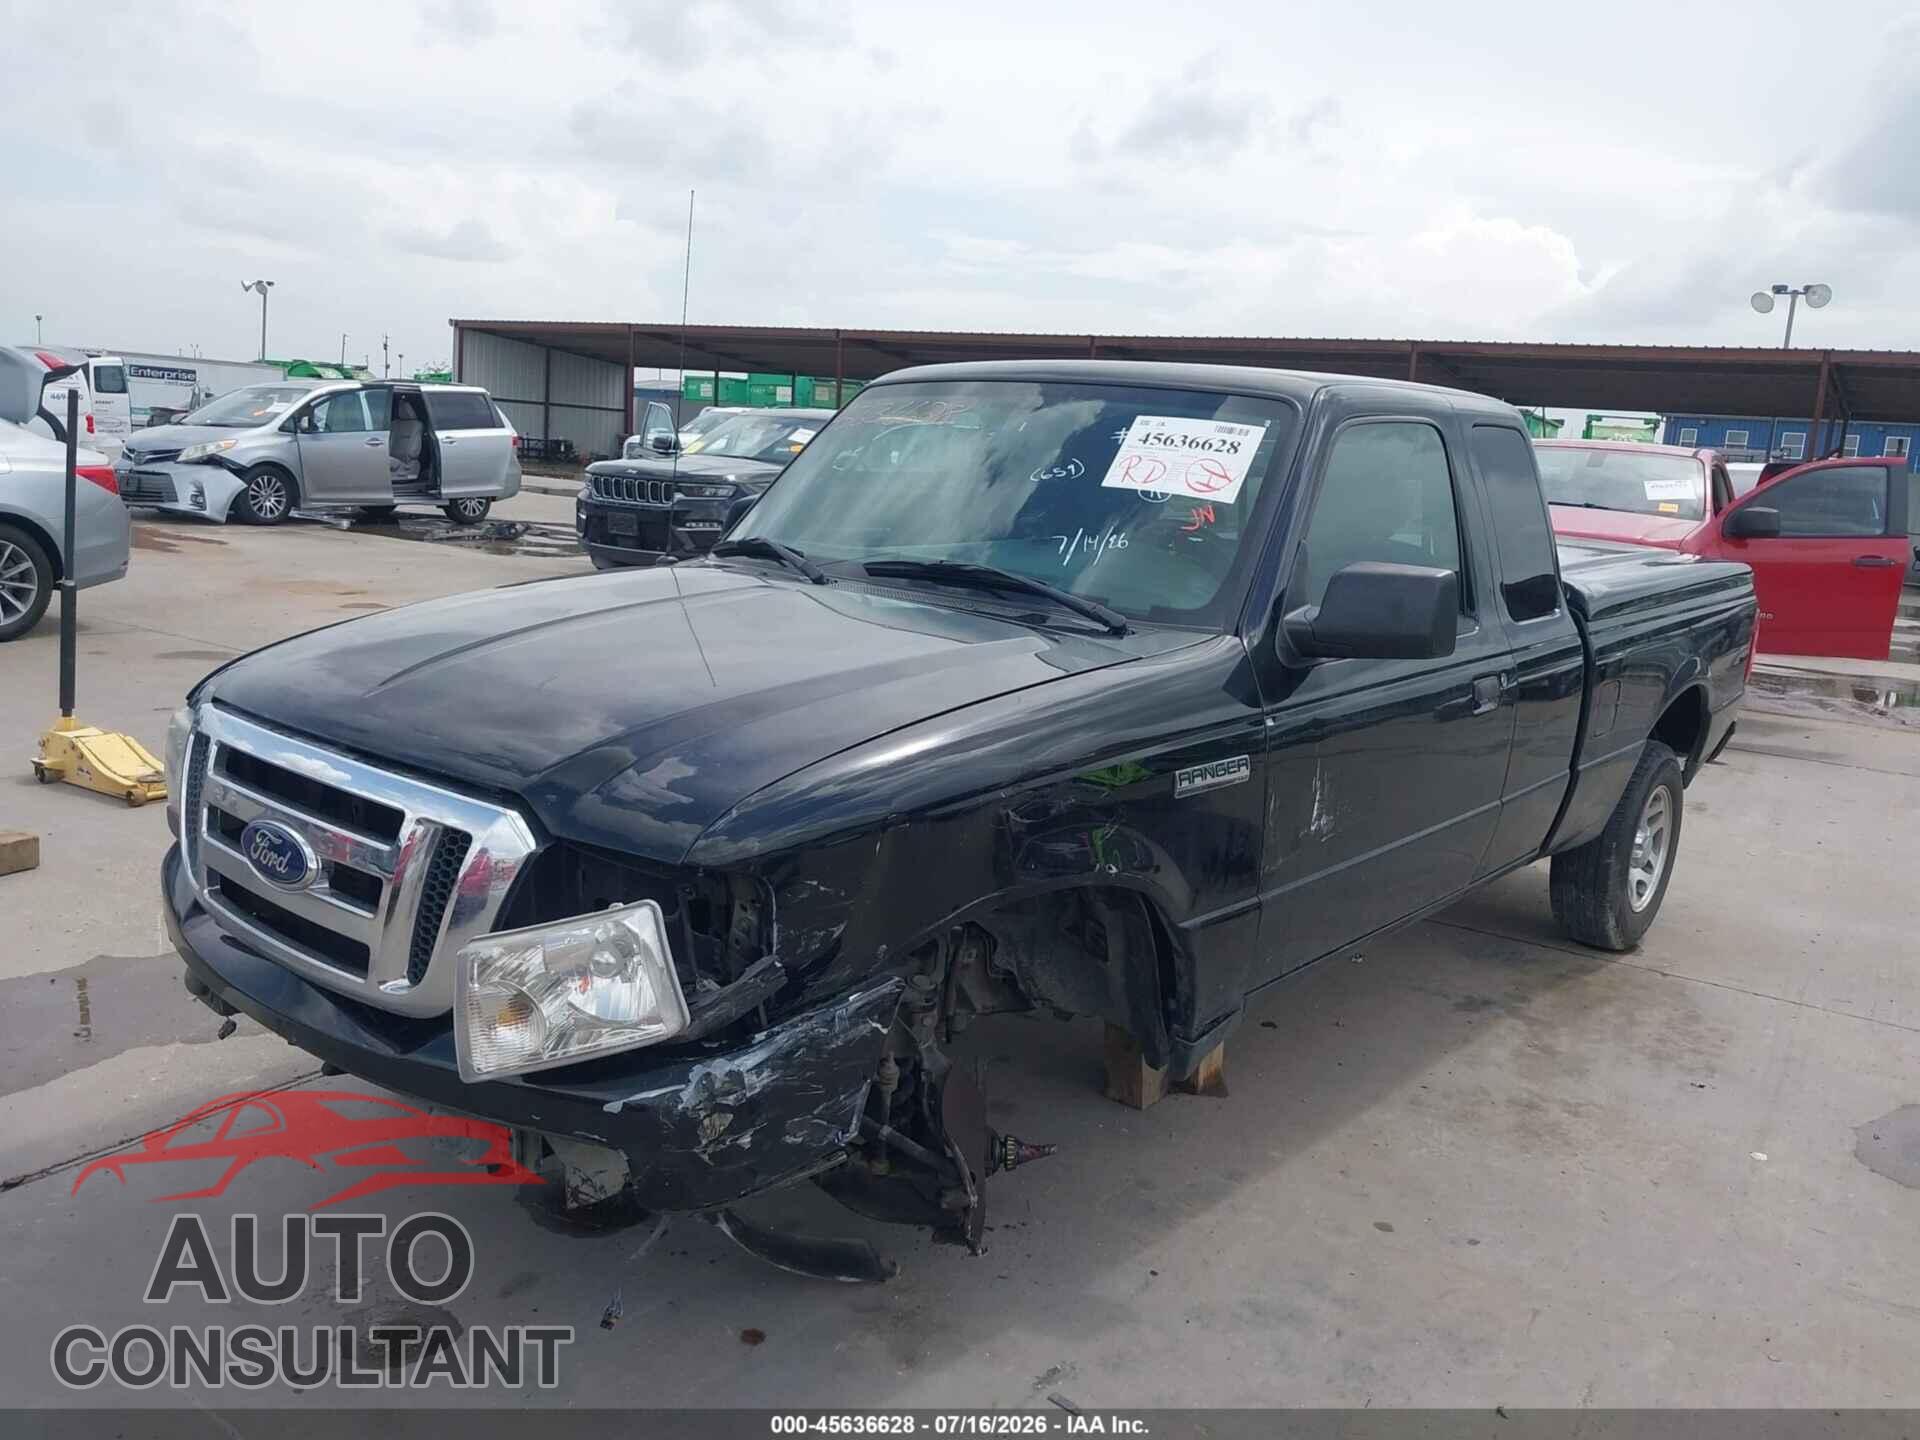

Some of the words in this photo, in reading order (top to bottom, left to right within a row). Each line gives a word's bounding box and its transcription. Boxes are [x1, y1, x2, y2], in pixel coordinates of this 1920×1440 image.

[130, 366, 196, 381] Enterprise
[1138, 431, 1242, 455] 45636628
[1178, 758, 1249, 787] RANGER
[250, 829, 293, 873] Ford
